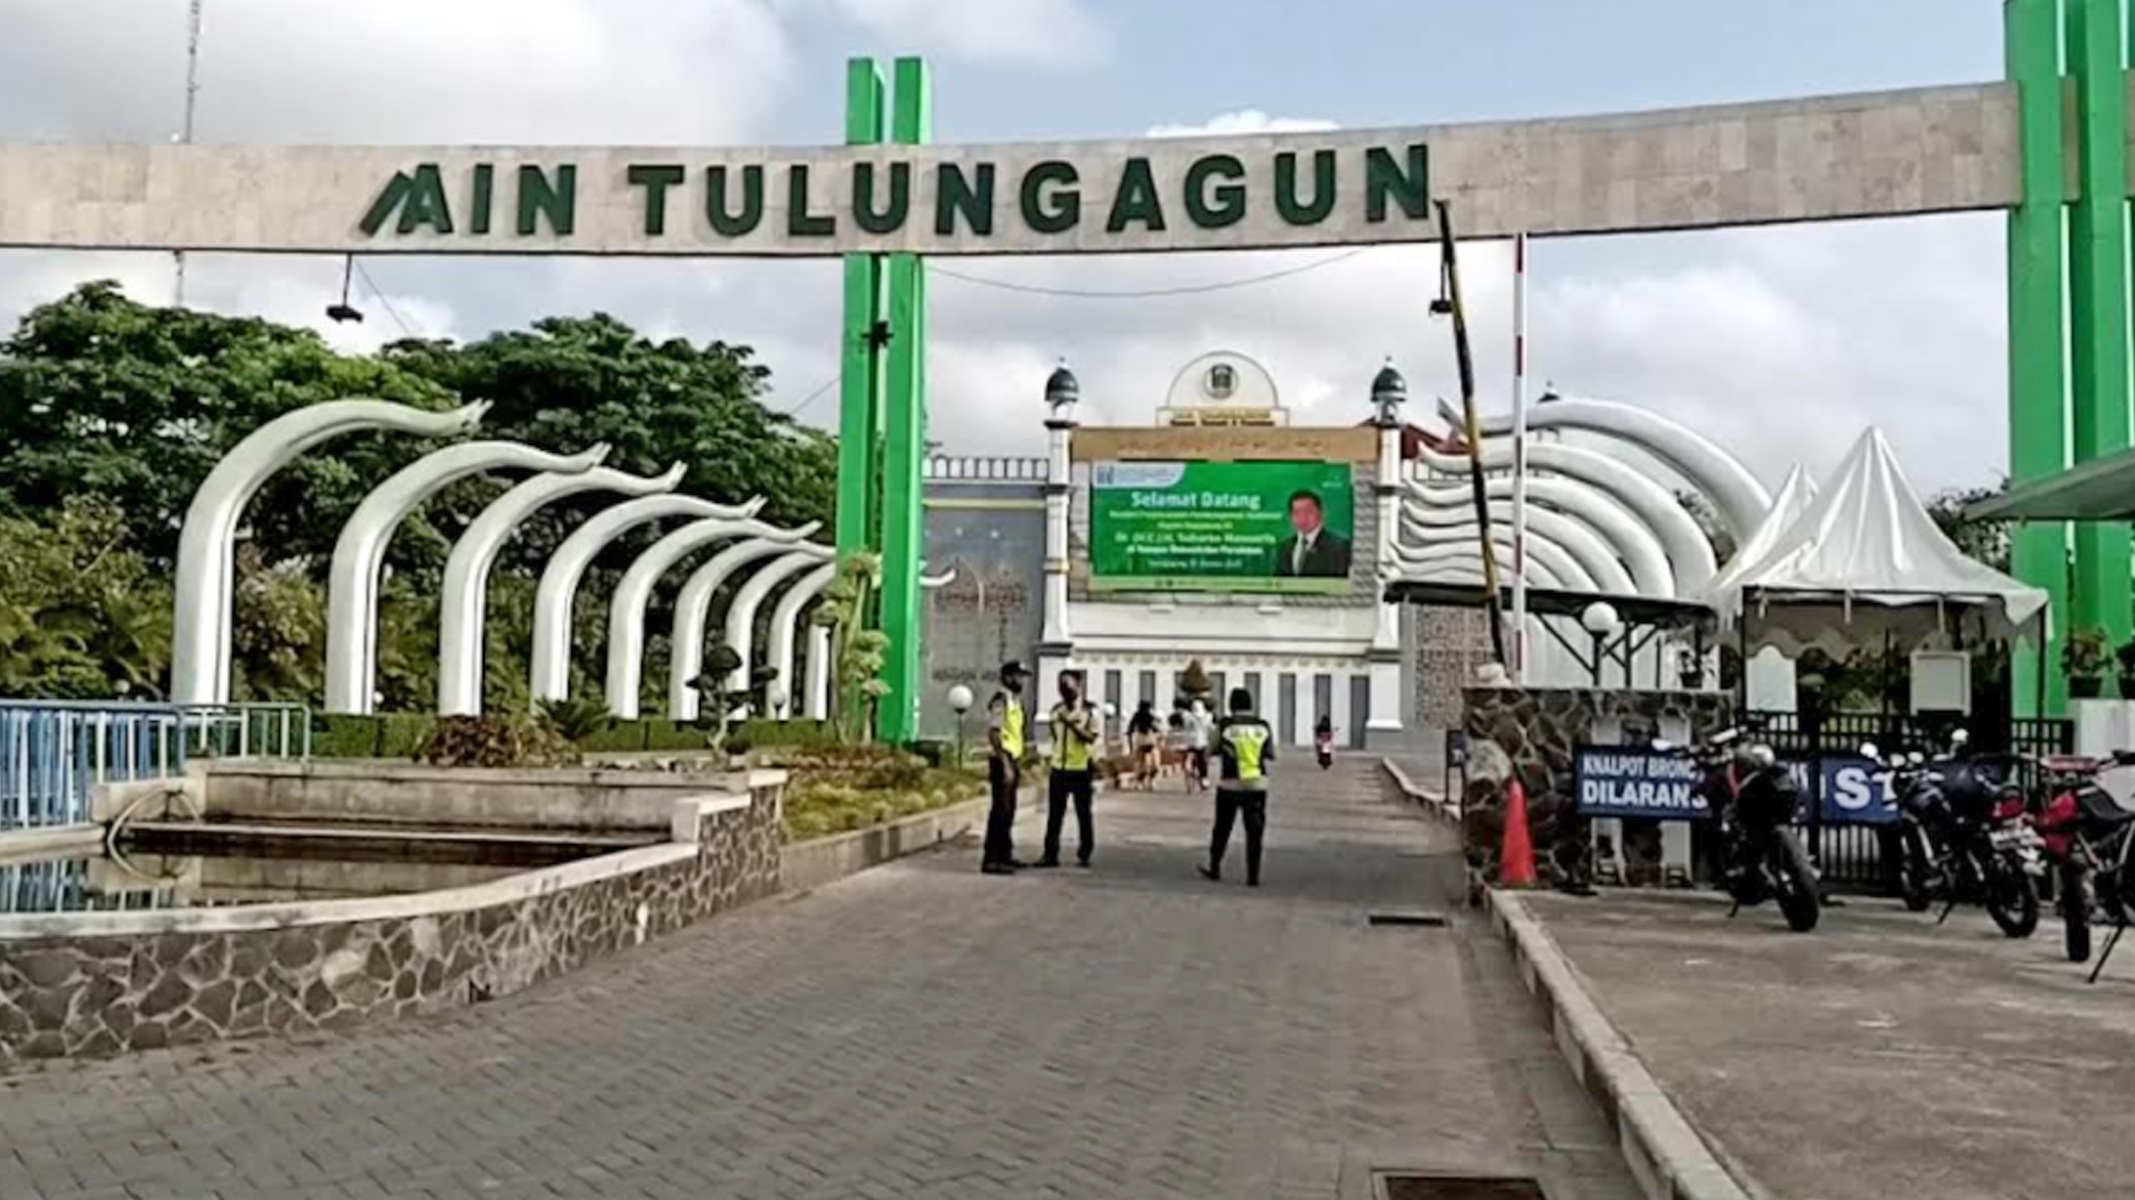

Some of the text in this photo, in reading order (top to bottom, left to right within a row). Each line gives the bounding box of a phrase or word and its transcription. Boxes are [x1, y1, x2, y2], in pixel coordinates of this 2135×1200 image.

[628, 143, 1430, 238] TULUNGAGUN
[1131, 490, 1261, 510] Selamat Datang
[1582, 754, 1646, 777] KNALPOT
